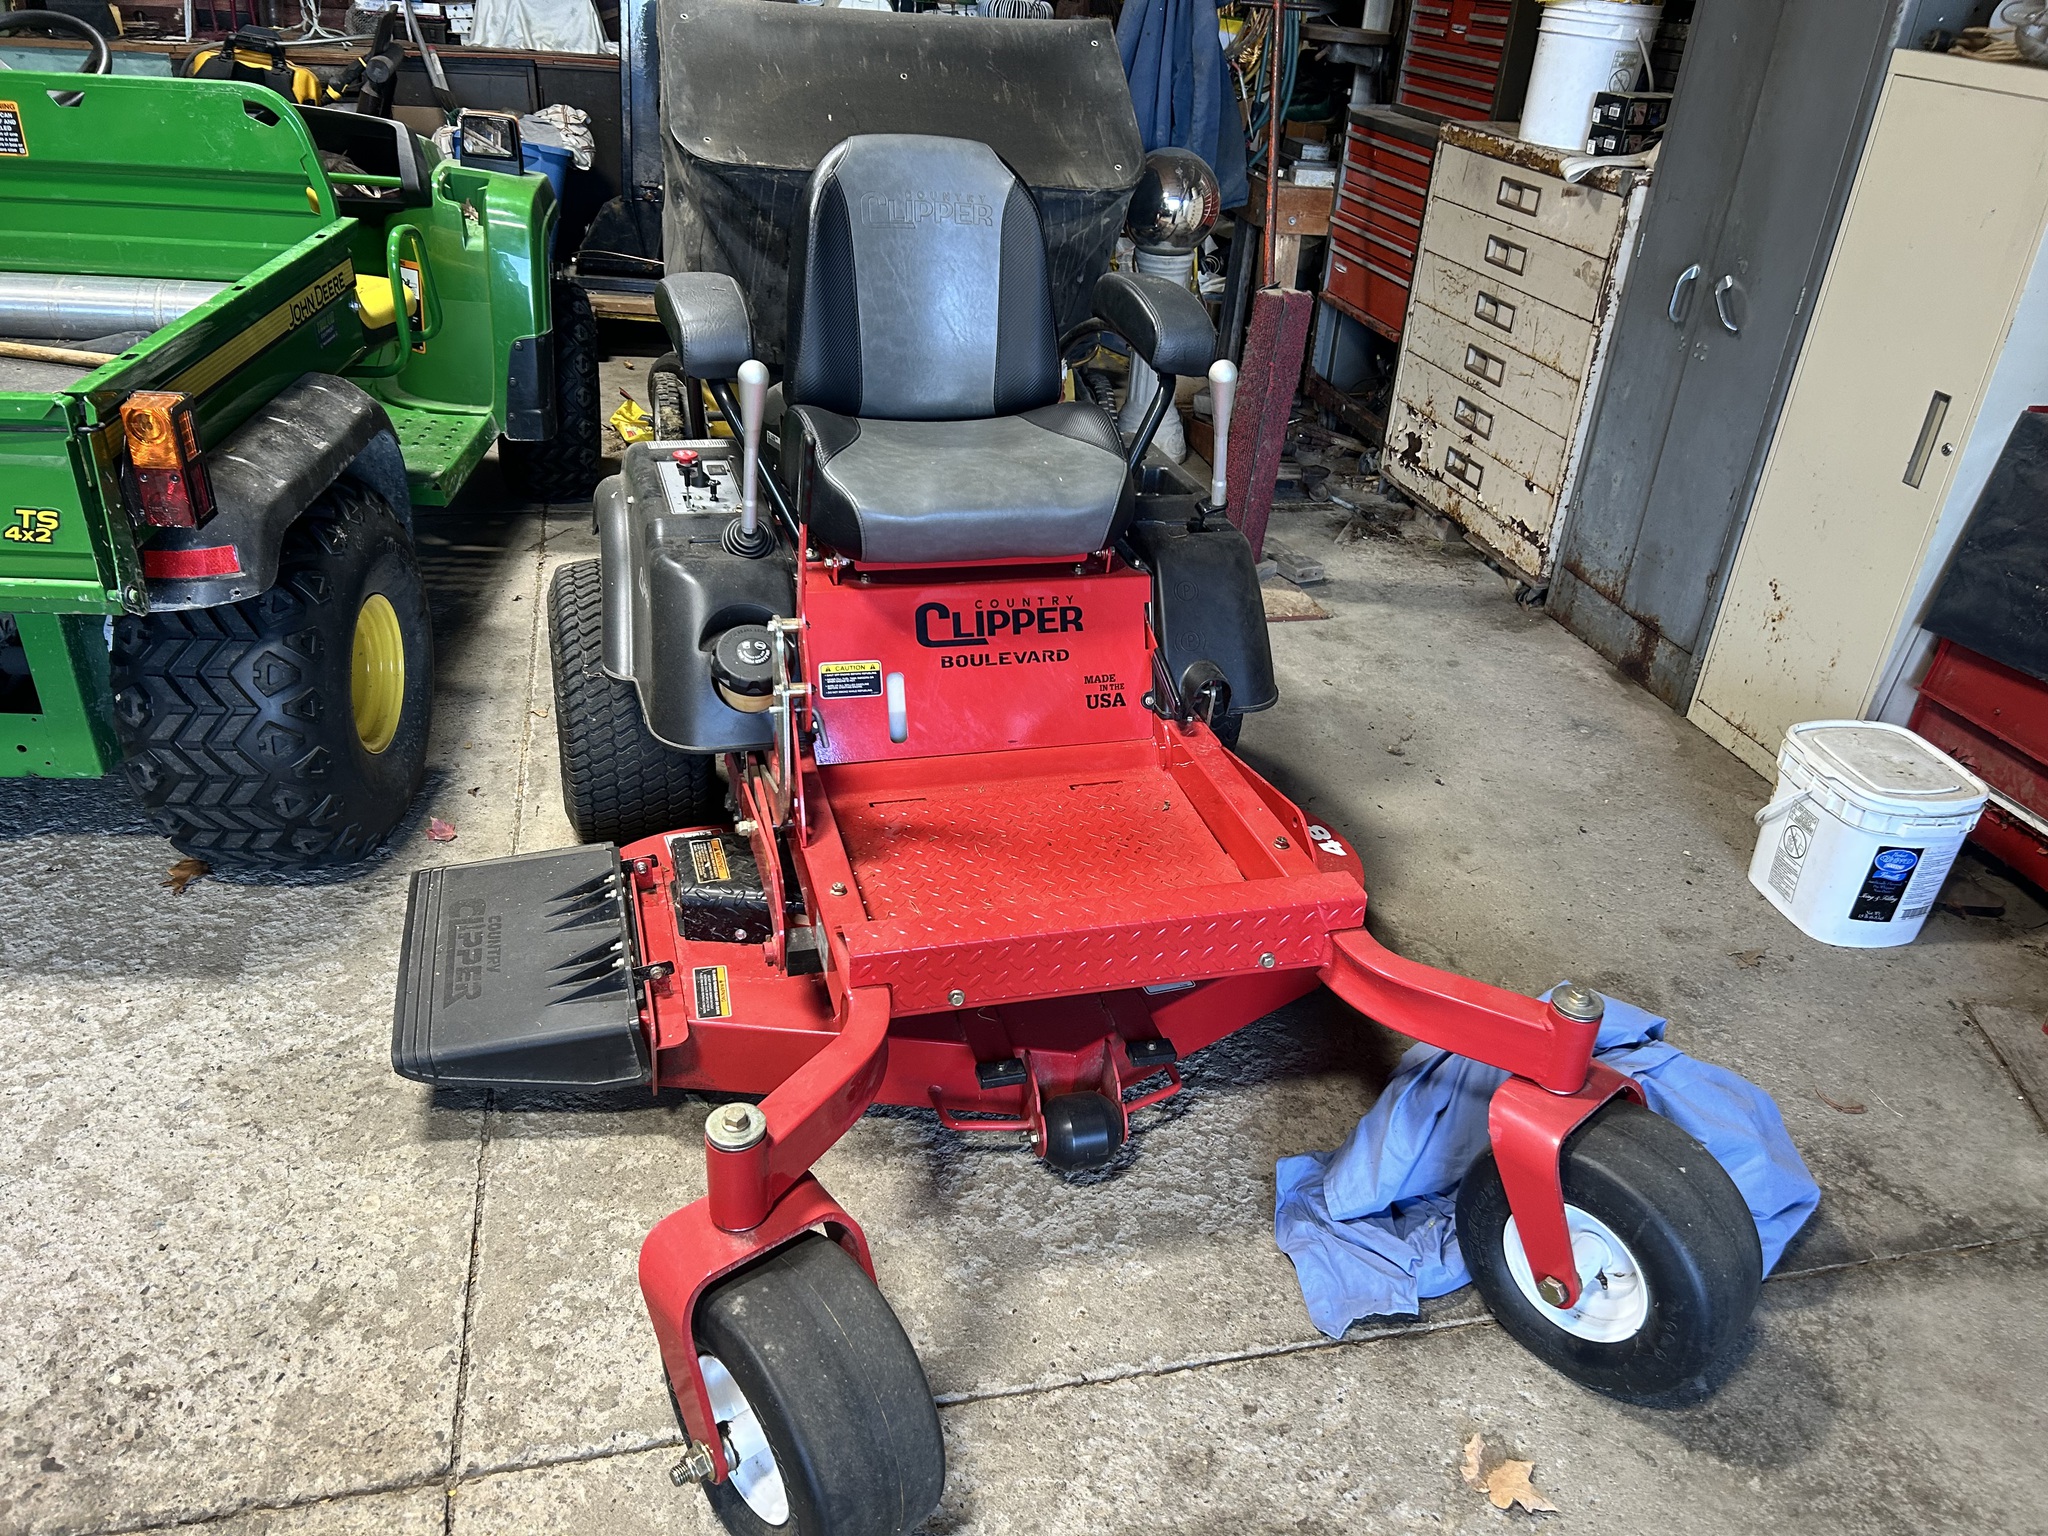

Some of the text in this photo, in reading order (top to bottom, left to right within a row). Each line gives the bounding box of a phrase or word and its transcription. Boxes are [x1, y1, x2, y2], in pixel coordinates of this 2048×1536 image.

[904, 190, 986, 203] COUNTRY
[860, 190, 993, 229] CLIPPER
[289, 272, 347, 328] JOHN DEERE
[15, 508, 59, 530] TS
[4, 526, 52, 543] 4x2
[974, 595, 1074, 610] COUNTRY
[915, 602, 1084, 649] CLIPPER
[834, 664, 866, 672] CAUTION
[940, 649, 1070, 669] BOULEVARD
[1083, 673, 1116, 685] MADE
[1099, 682, 1125, 692] IN THE
[1085, 692, 1127, 710] USA
[1307, 824, 1348, 856] 48
[443, 898, 487, 1009] CLIPPER
[487, 915, 502, 973] COUNTRY
